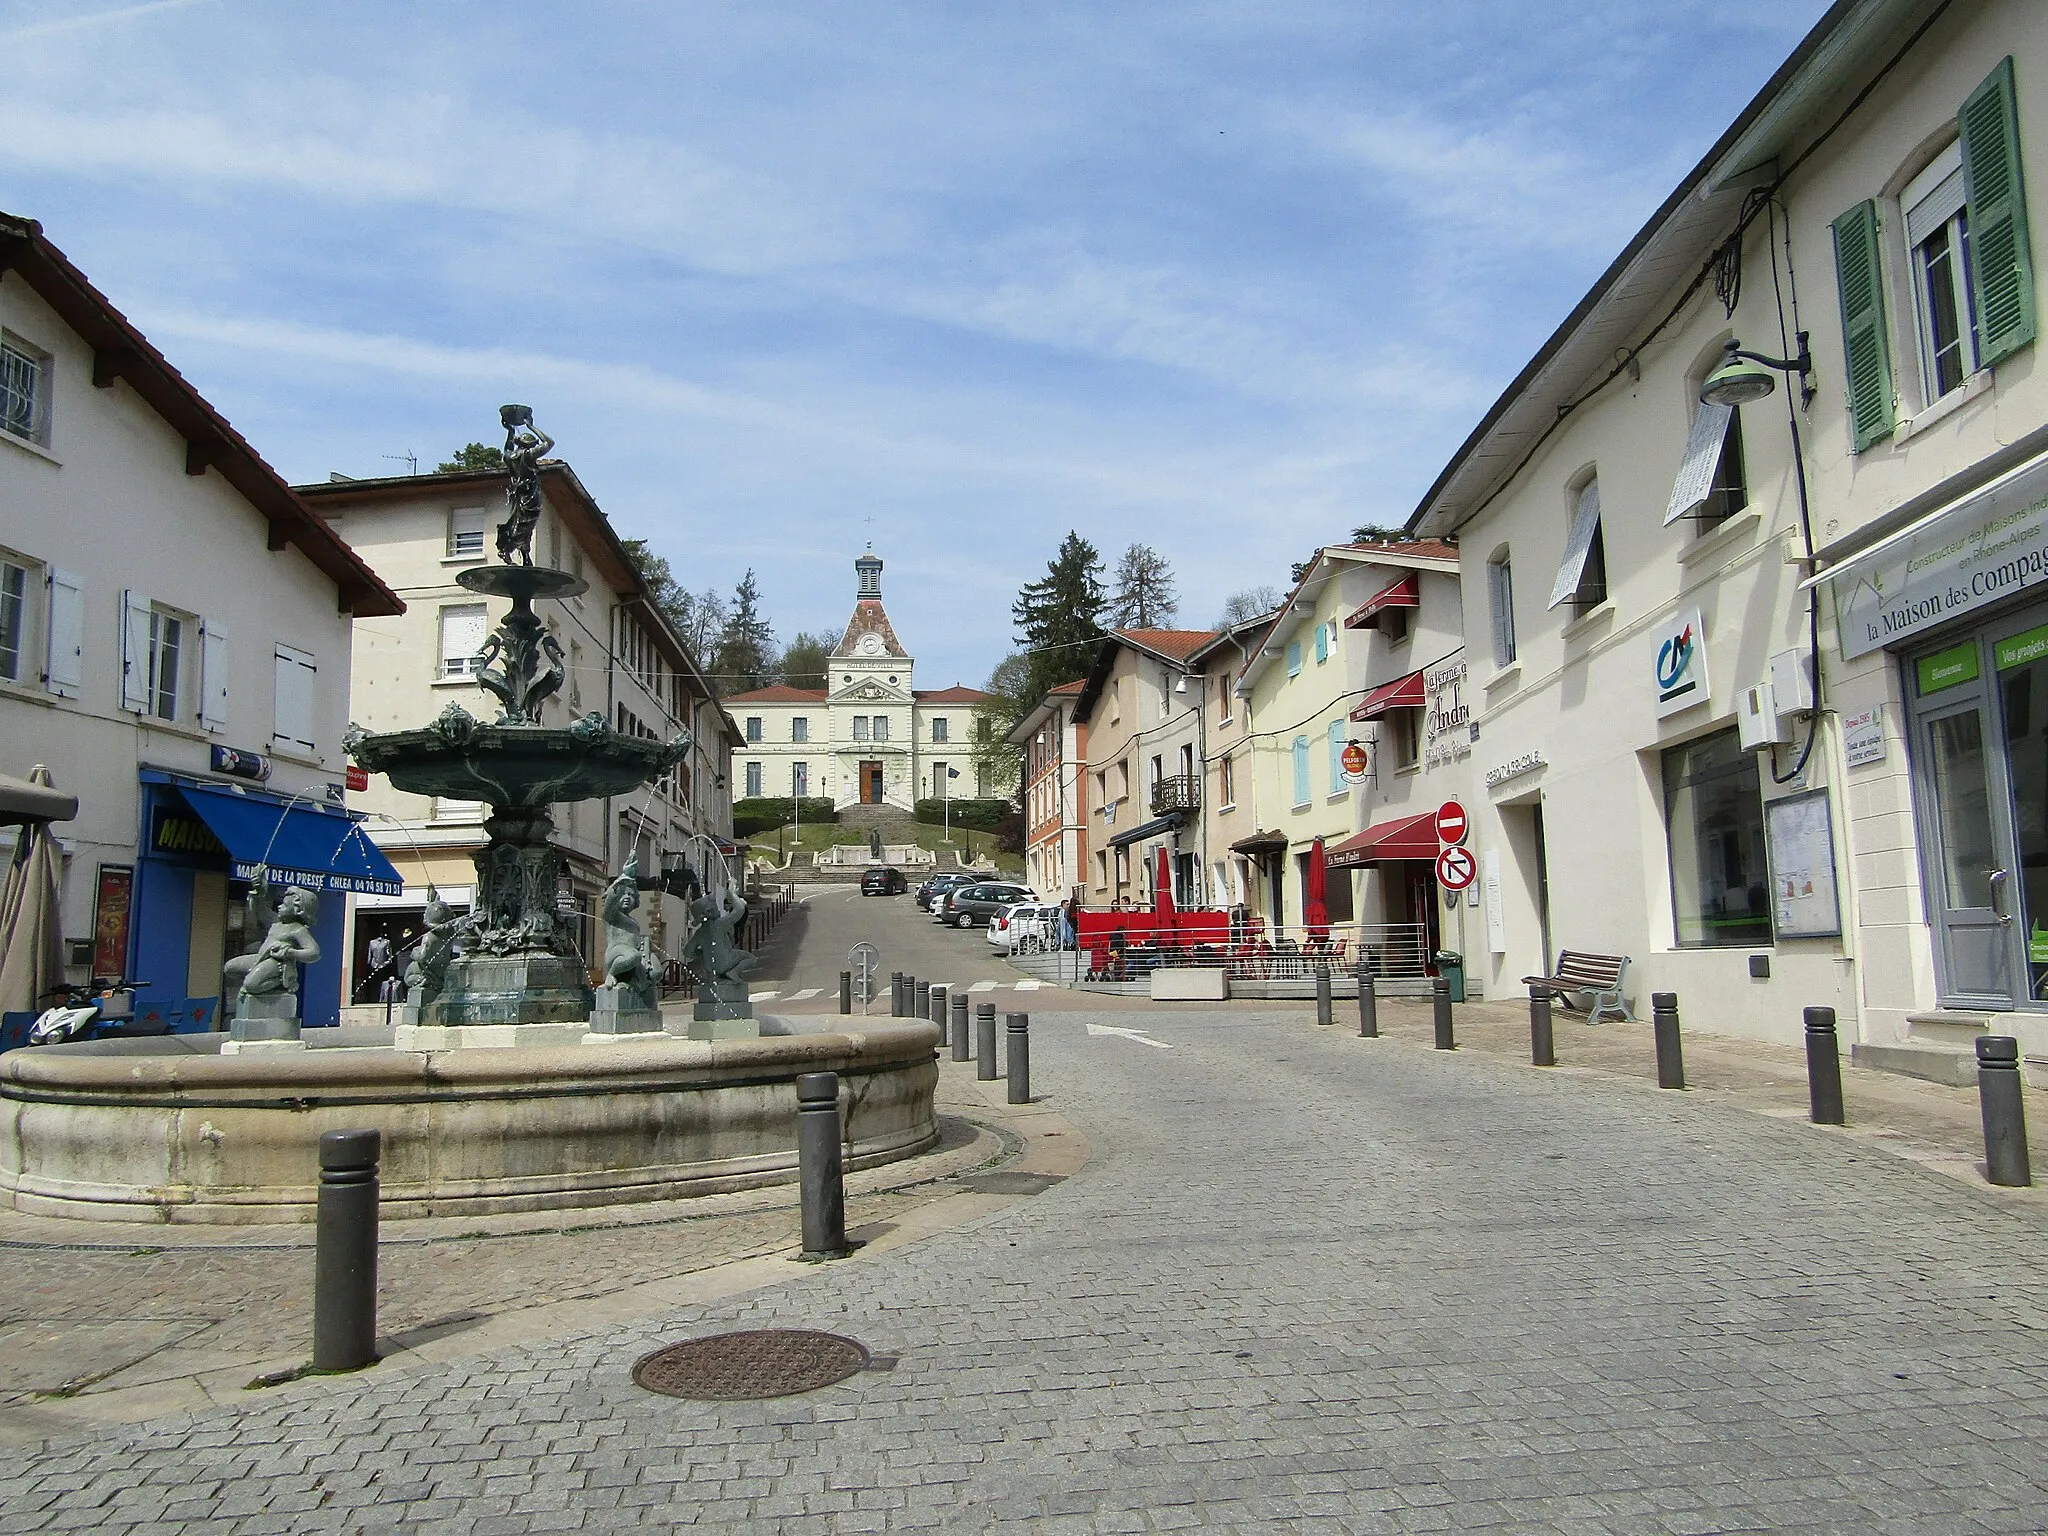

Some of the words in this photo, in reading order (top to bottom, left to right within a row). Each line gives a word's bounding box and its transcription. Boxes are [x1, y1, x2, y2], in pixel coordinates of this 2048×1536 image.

[1906, 536, 1966, 574] Constructeur
[1968, 529, 1981, 544] de
[1984, 508, 2027, 538] Maisons
[1958, 559, 1972, 570] en
[1866, 623, 1879, 642] la
[1881, 595, 1942, 636] Maison
[1945, 586, 1970, 610] des
[272, 869, 283, 883] DE
[285, 871, 295, 884] LA
[296, 873, 325, 887] PRESSE
[385, 882, 393, 894] 71
